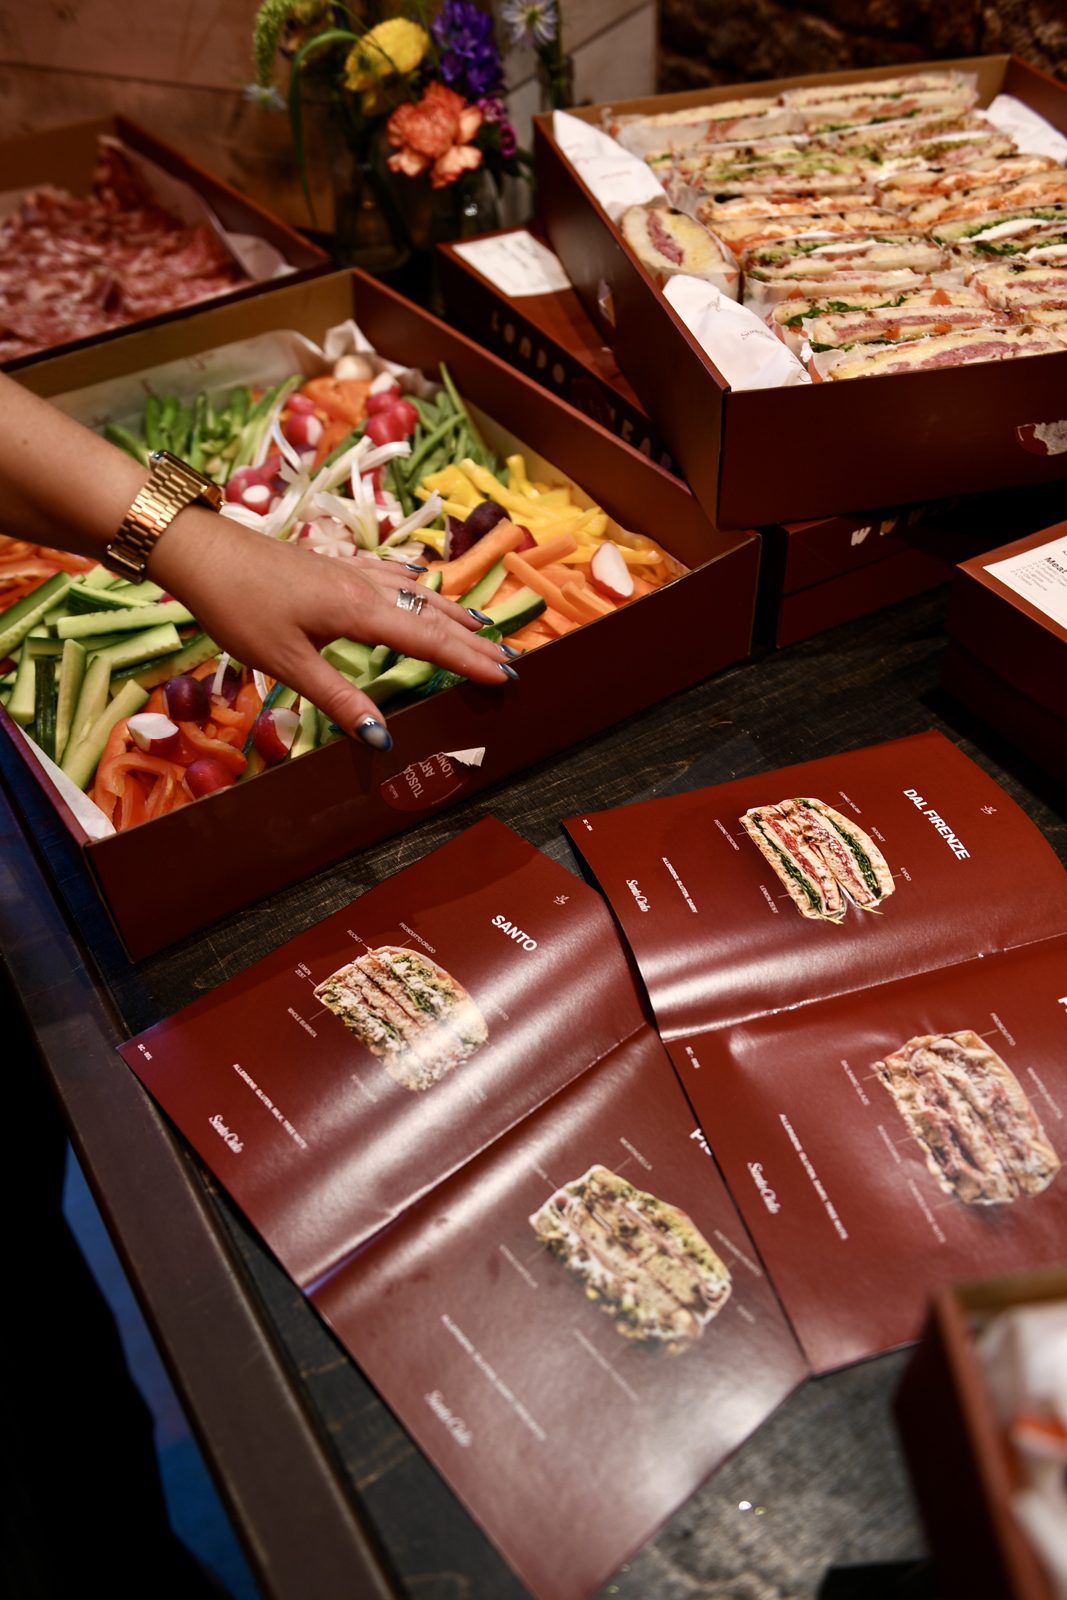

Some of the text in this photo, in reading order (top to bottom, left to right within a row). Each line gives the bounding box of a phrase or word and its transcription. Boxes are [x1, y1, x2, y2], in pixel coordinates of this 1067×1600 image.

[903, 788, 971, 861] DAL FIRENZE
[491, 915, 537, 952] SANTO
[294, 968, 306, 979] ZEST
[297, 962, 312, 976] LEMON
